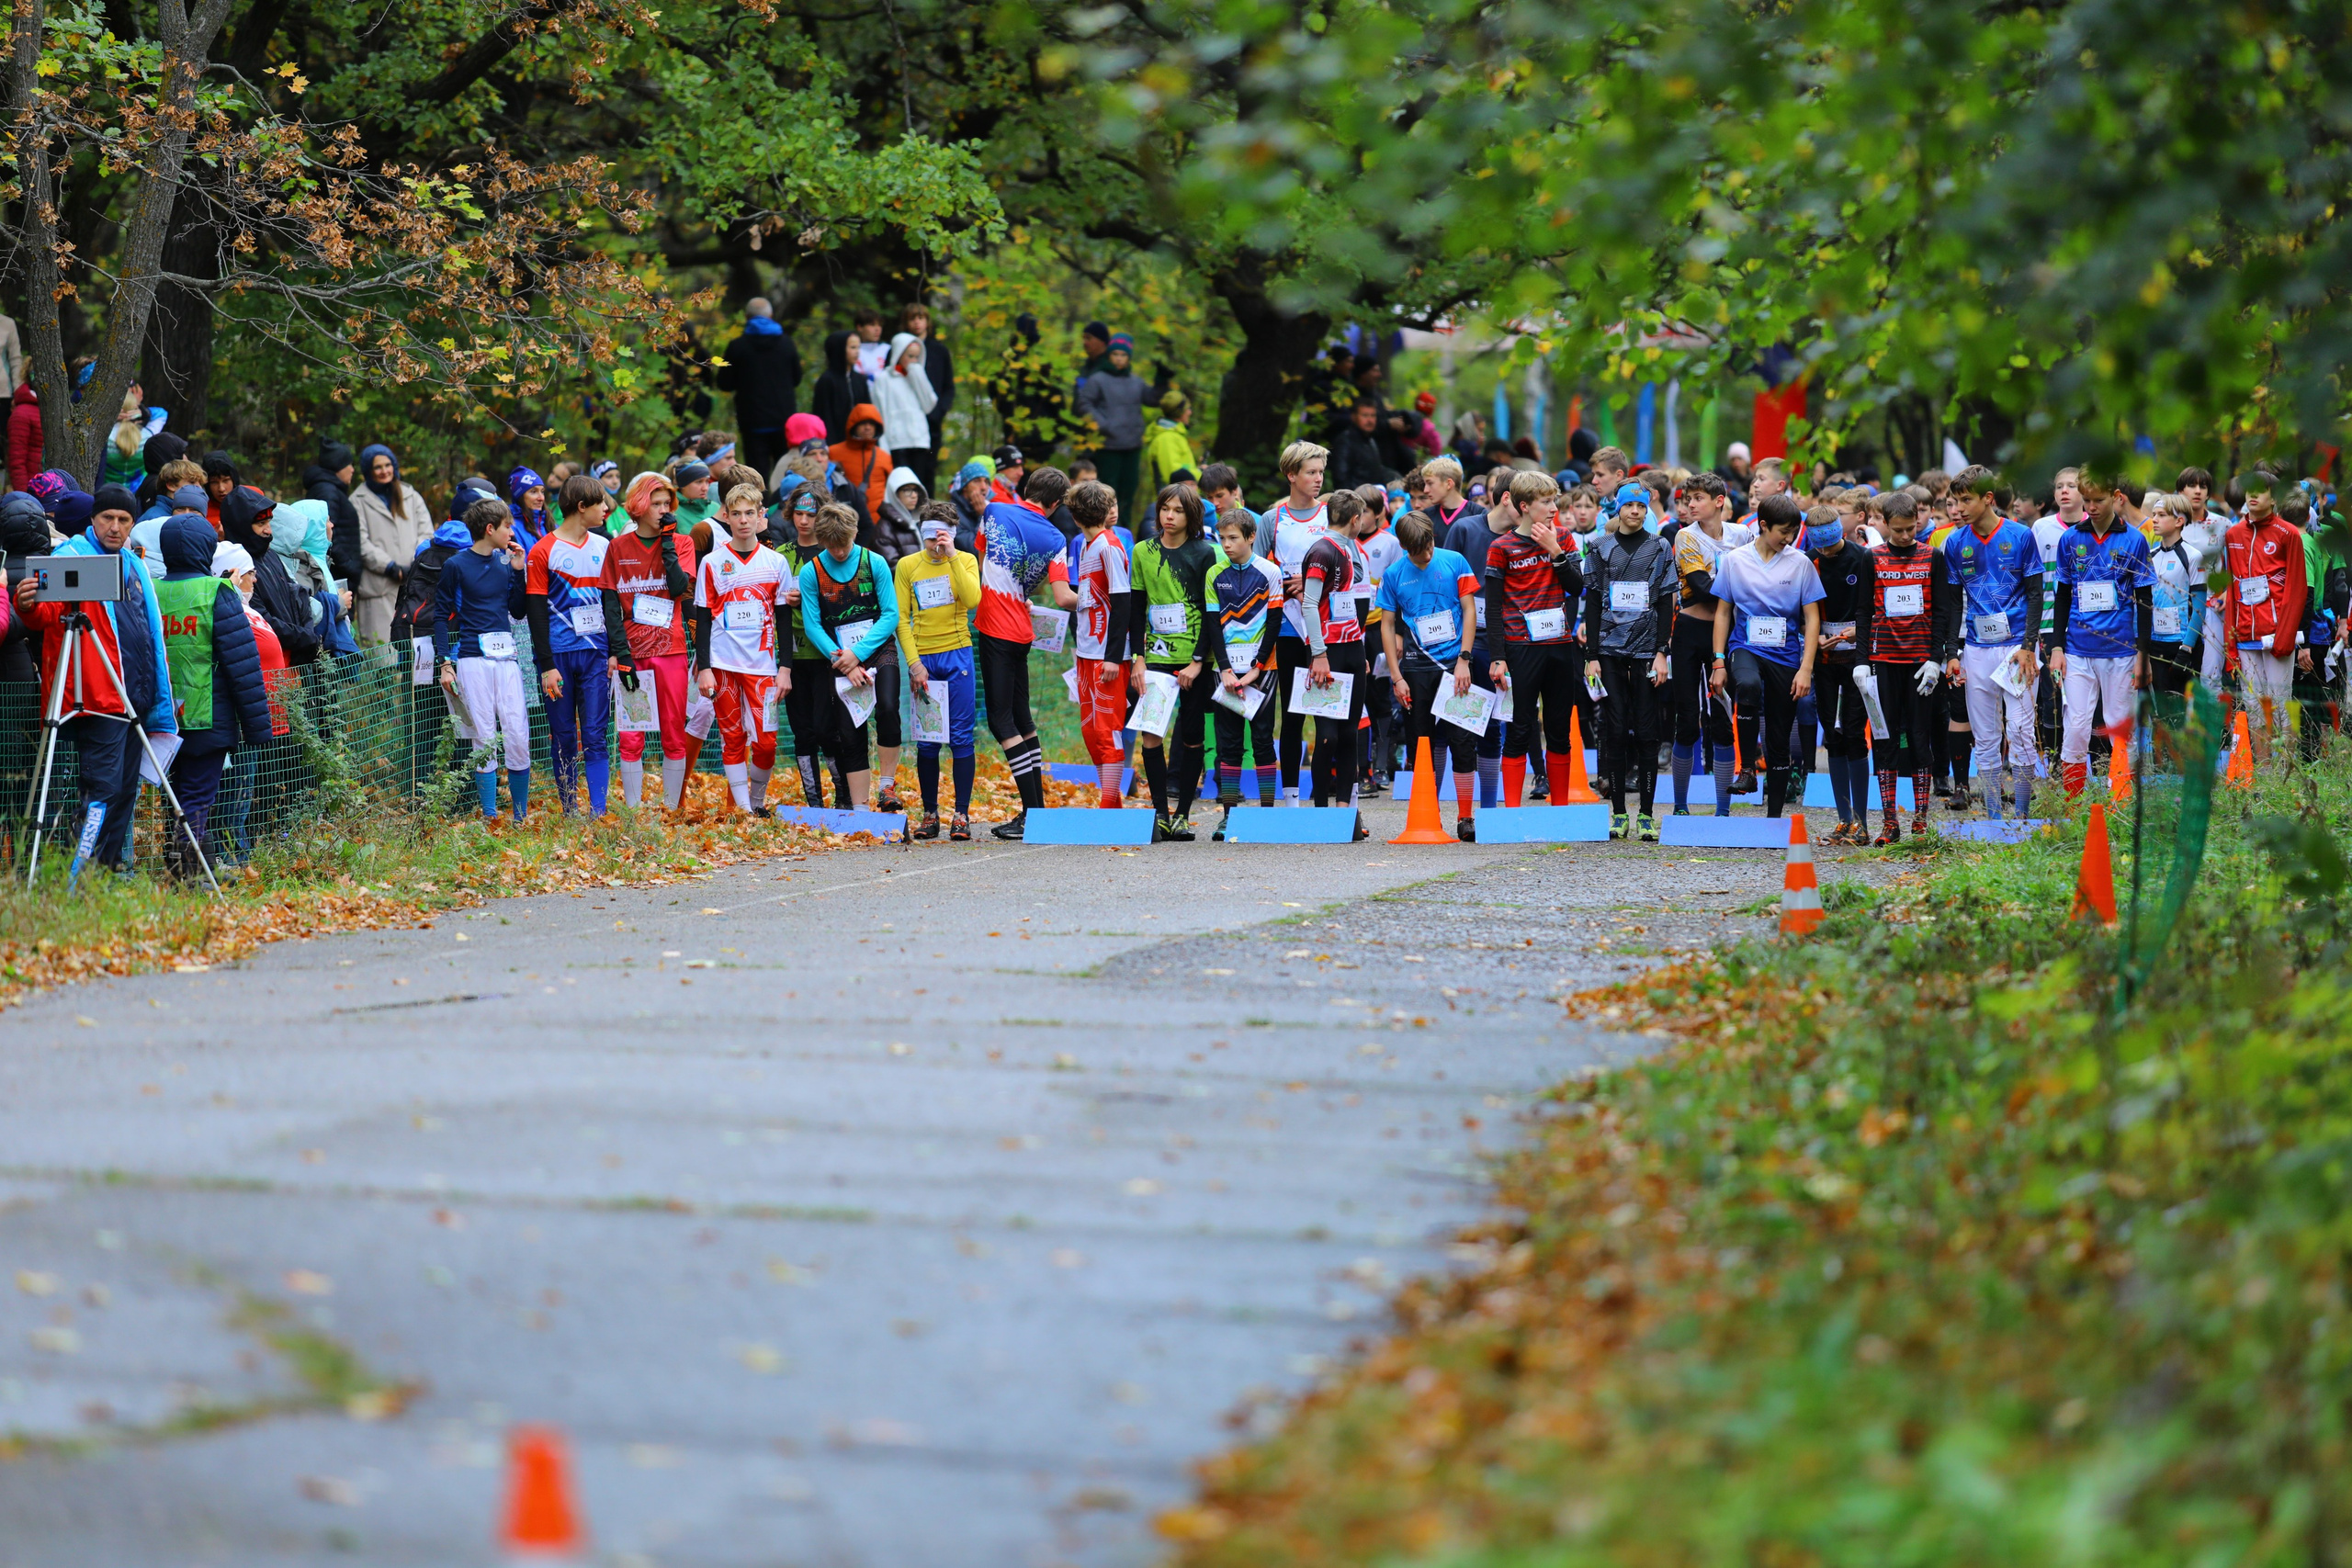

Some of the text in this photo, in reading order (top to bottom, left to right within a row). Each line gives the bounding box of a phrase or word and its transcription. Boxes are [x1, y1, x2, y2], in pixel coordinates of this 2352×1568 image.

[1509, 556, 1537, 570] NORD
[1332, 566, 1340, 592] ЛЕНСК
[1877, 570, 1929, 579] NORD WEST
[927, 590, 941, 599] 217
[1896, 594, 1911, 603] 203
[644, 607, 659, 616] 222
[737, 611, 751, 619] 220
[582, 616, 594, 625] 223
[1095, 611, 1104, 636] think
[1541, 621, 1554, 629] 208
[1428, 625, 1442, 634] 209
[1758, 627, 1772, 636] 205
[1231, 655, 1244, 663] 213
[78, 807, 103, 860] RUSSIA
